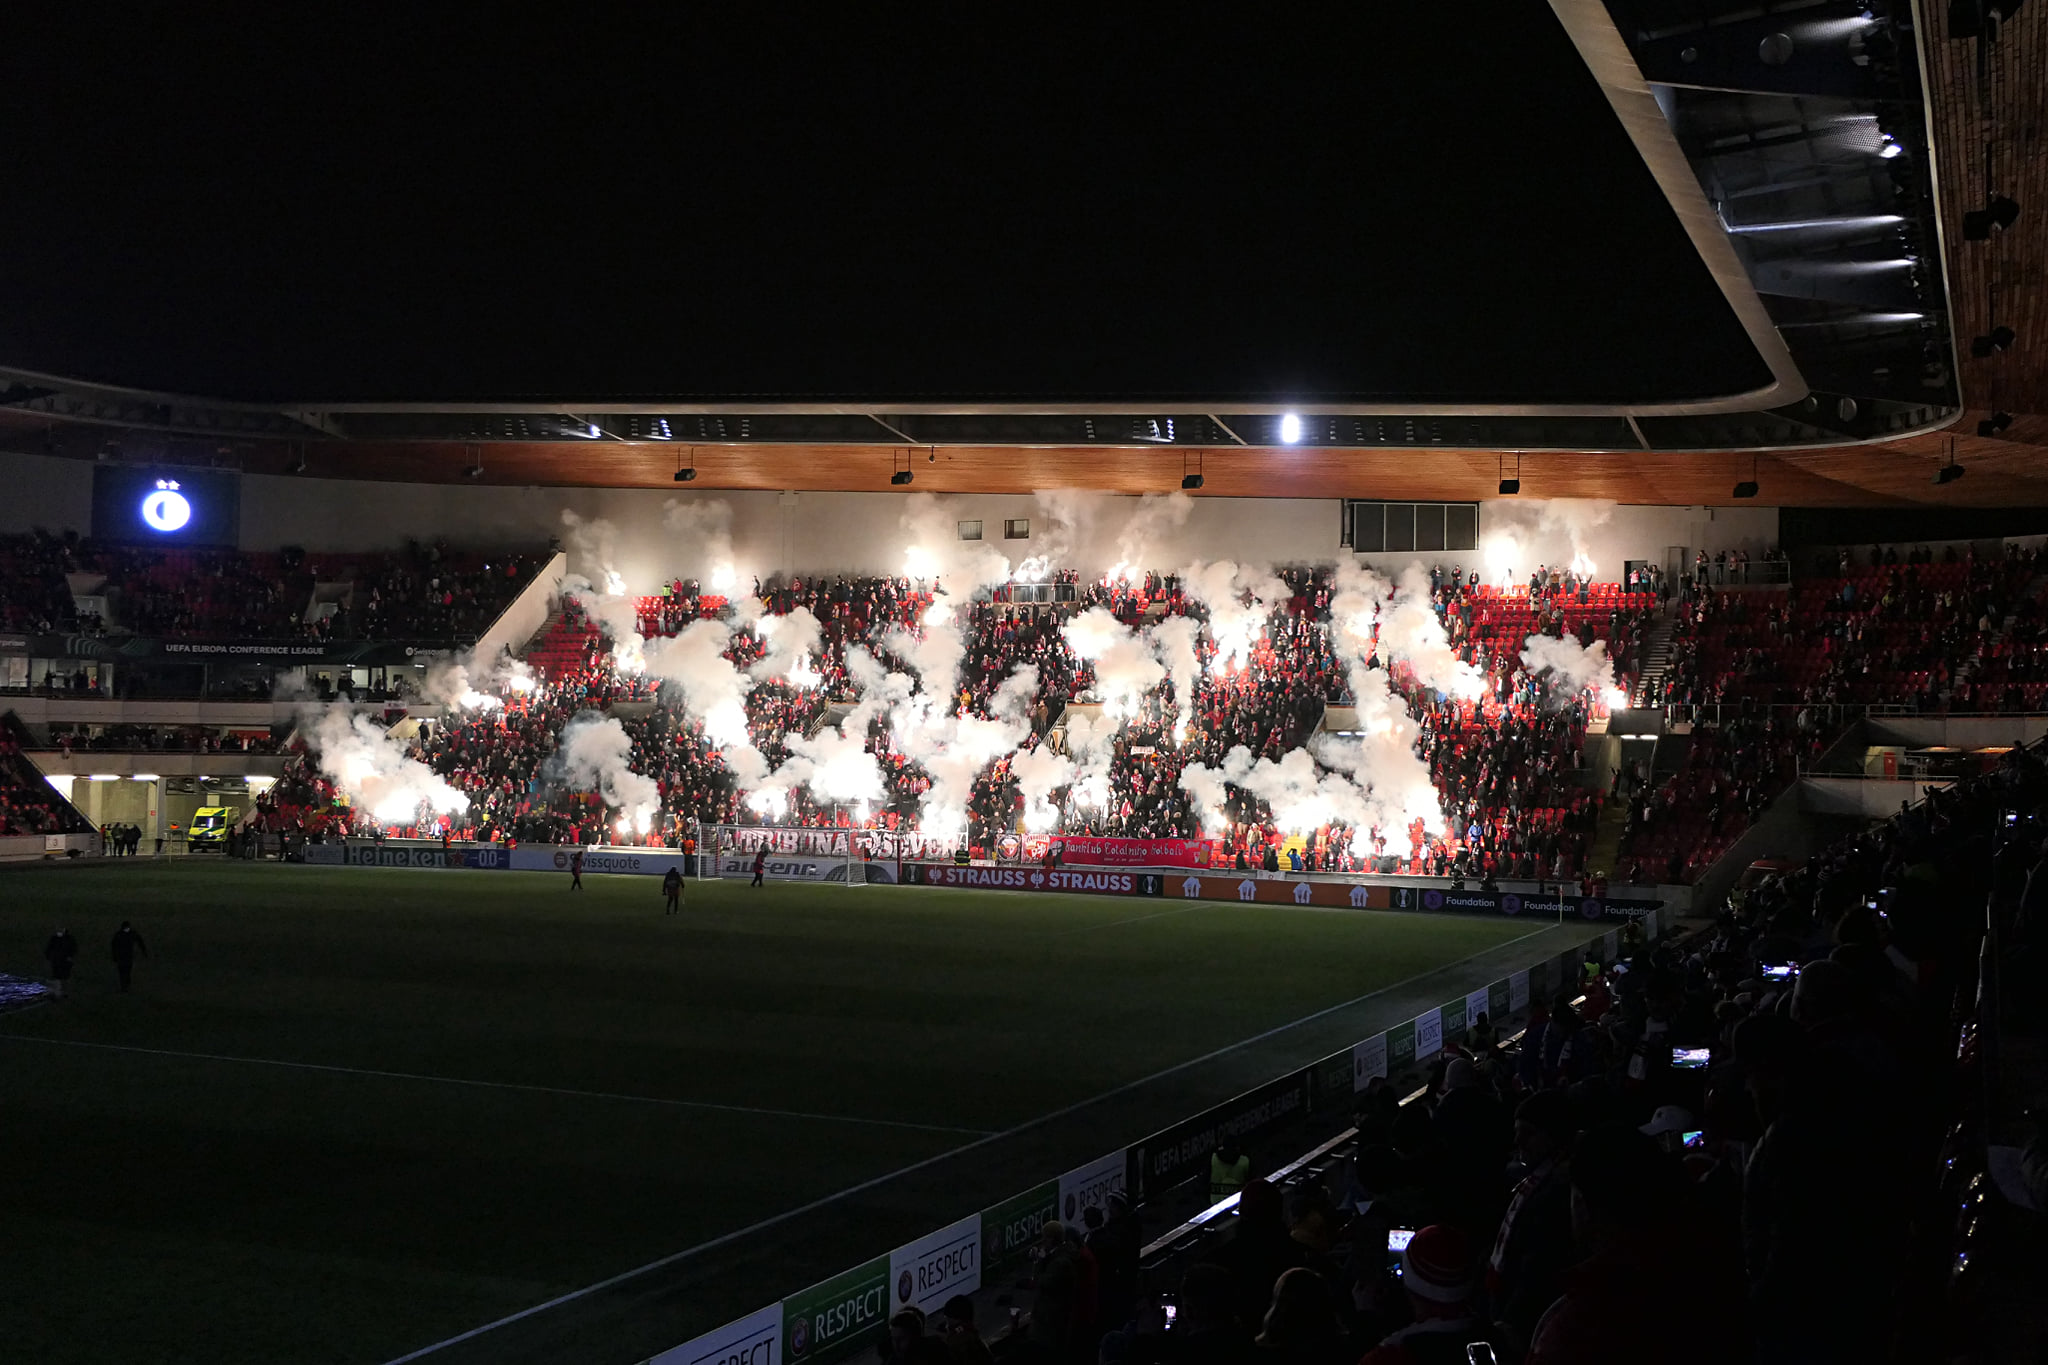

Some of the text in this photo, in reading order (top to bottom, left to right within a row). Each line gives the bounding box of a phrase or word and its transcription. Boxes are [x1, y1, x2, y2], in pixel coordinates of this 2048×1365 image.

[165, 644, 324, 655] UEFA EUROPA CONFERENCE LEAGUE
[349, 847, 447, 867] Heineken
[946, 867, 1026, 887] STRAUSS
[1049, 872, 1132, 892] STRAUSS
[1446, 896, 1495, 908] Foundation
[1524, 901, 1575, 913] Foundation
[1605, 906, 1650, 918] Foundatio
[1153, 1145, 1181, 1176] UEFA
[1005, 1203, 1055, 1250] RESPECT
[918, 1242, 976, 1293] RESPECT
[815, 1284, 885, 1343] RESPECT
